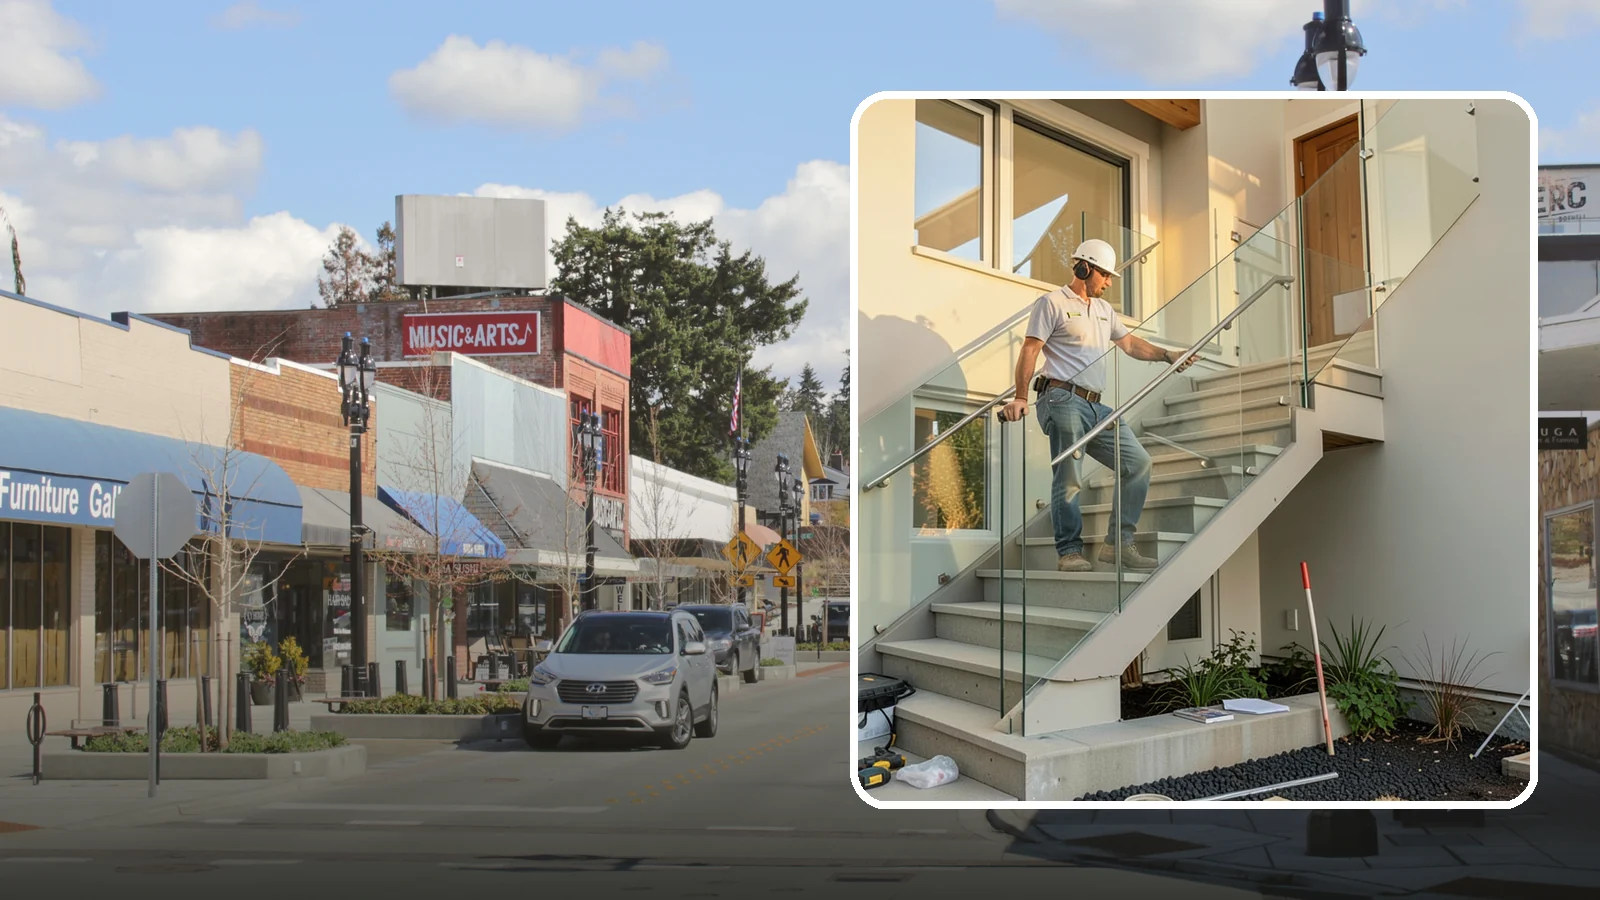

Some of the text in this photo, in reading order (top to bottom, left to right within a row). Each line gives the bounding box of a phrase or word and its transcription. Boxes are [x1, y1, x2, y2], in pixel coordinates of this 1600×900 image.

[408, 323, 520, 349] MUSIC&ARTS
[0, 471, 122, 519] Furniture Gal
[453, 563, 479, 574] SUSHI
